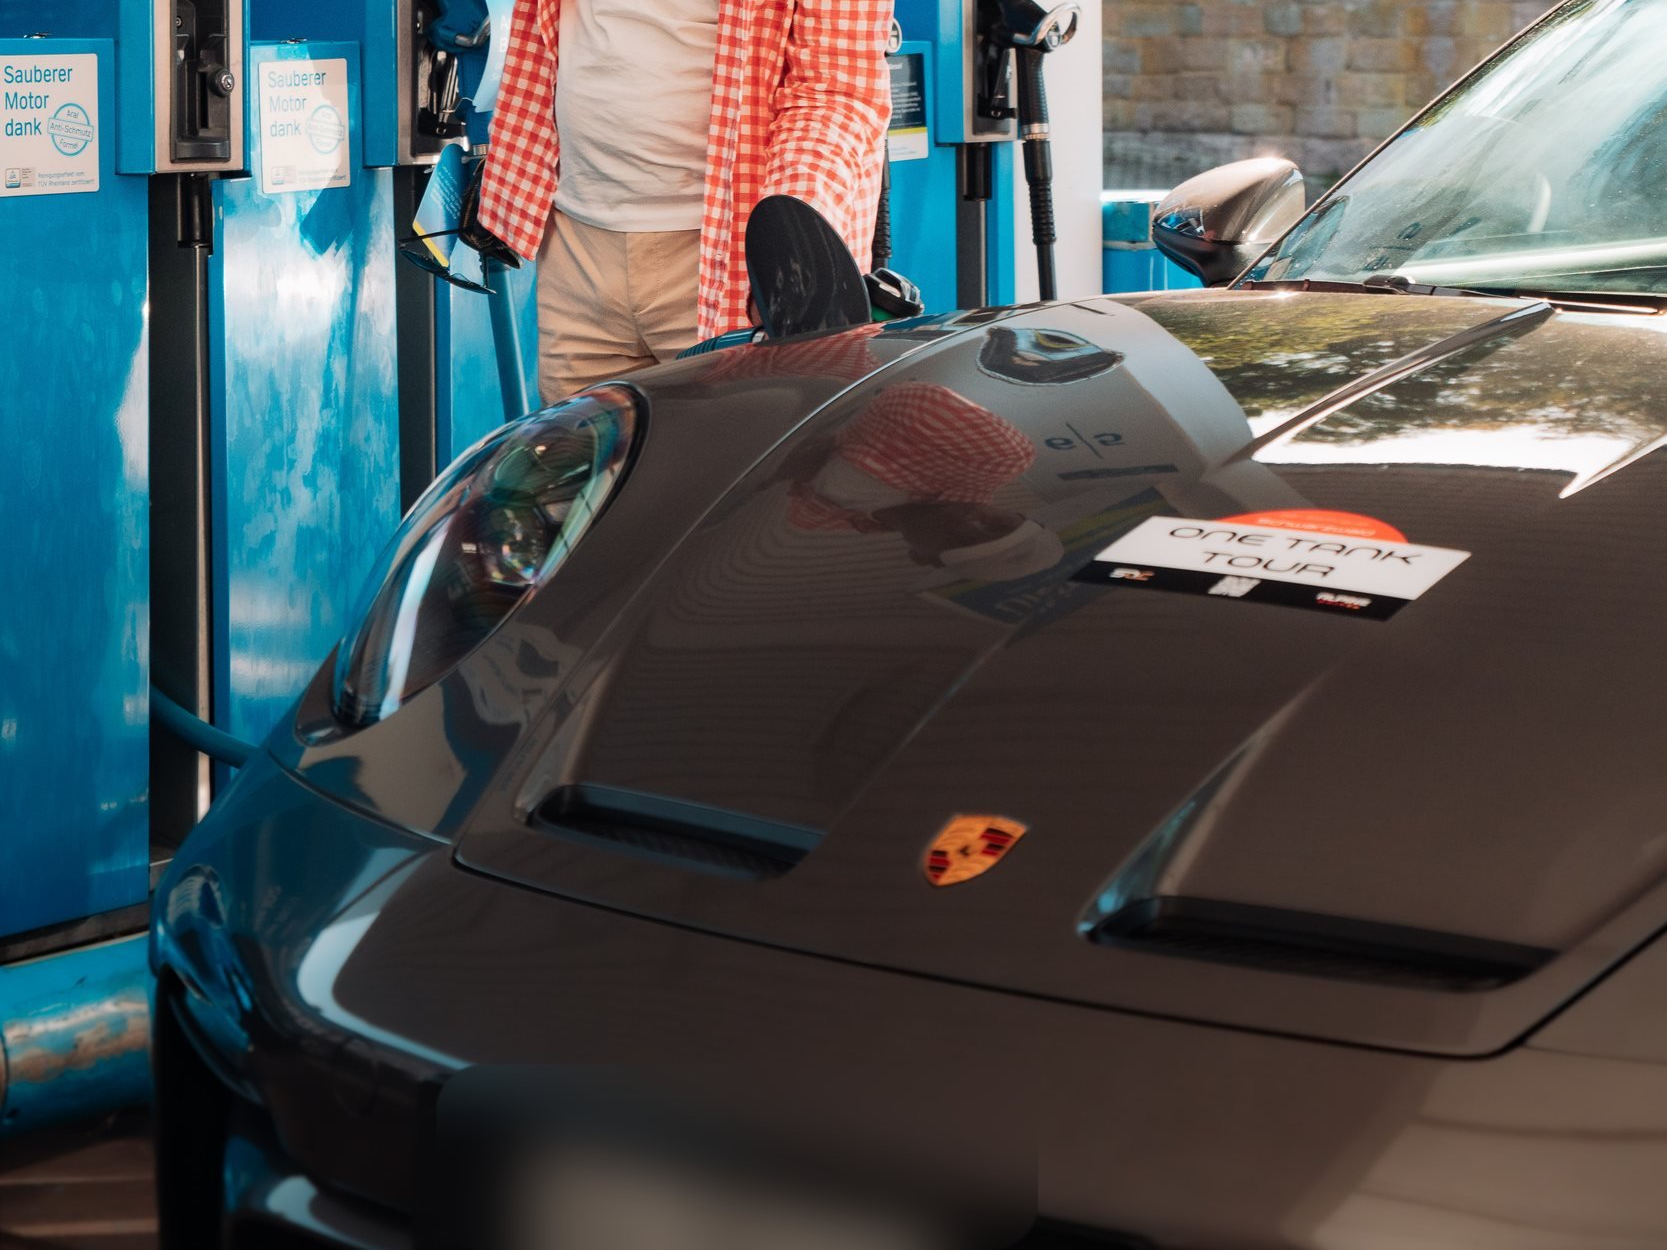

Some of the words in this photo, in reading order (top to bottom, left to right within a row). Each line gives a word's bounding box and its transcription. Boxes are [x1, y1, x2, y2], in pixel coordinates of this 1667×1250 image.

[3, 65, 73, 84] Sauberer
[268, 71, 326, 88] Sauberer
[4, 91, 49, 110] Motor
[269, 95, 307, 113] Motor
[66, 109, 80, 119] Aral
[5, 117, 42, 136] dank
[49, 121, 92, 138] Anti-Schmutz
[270, 120, 302, 137] dank
[1169, 526, 1272, 547] ONE
[1286, 537, 1423, 565] TANK
[1202, 550, 1336, 578] TOUR
